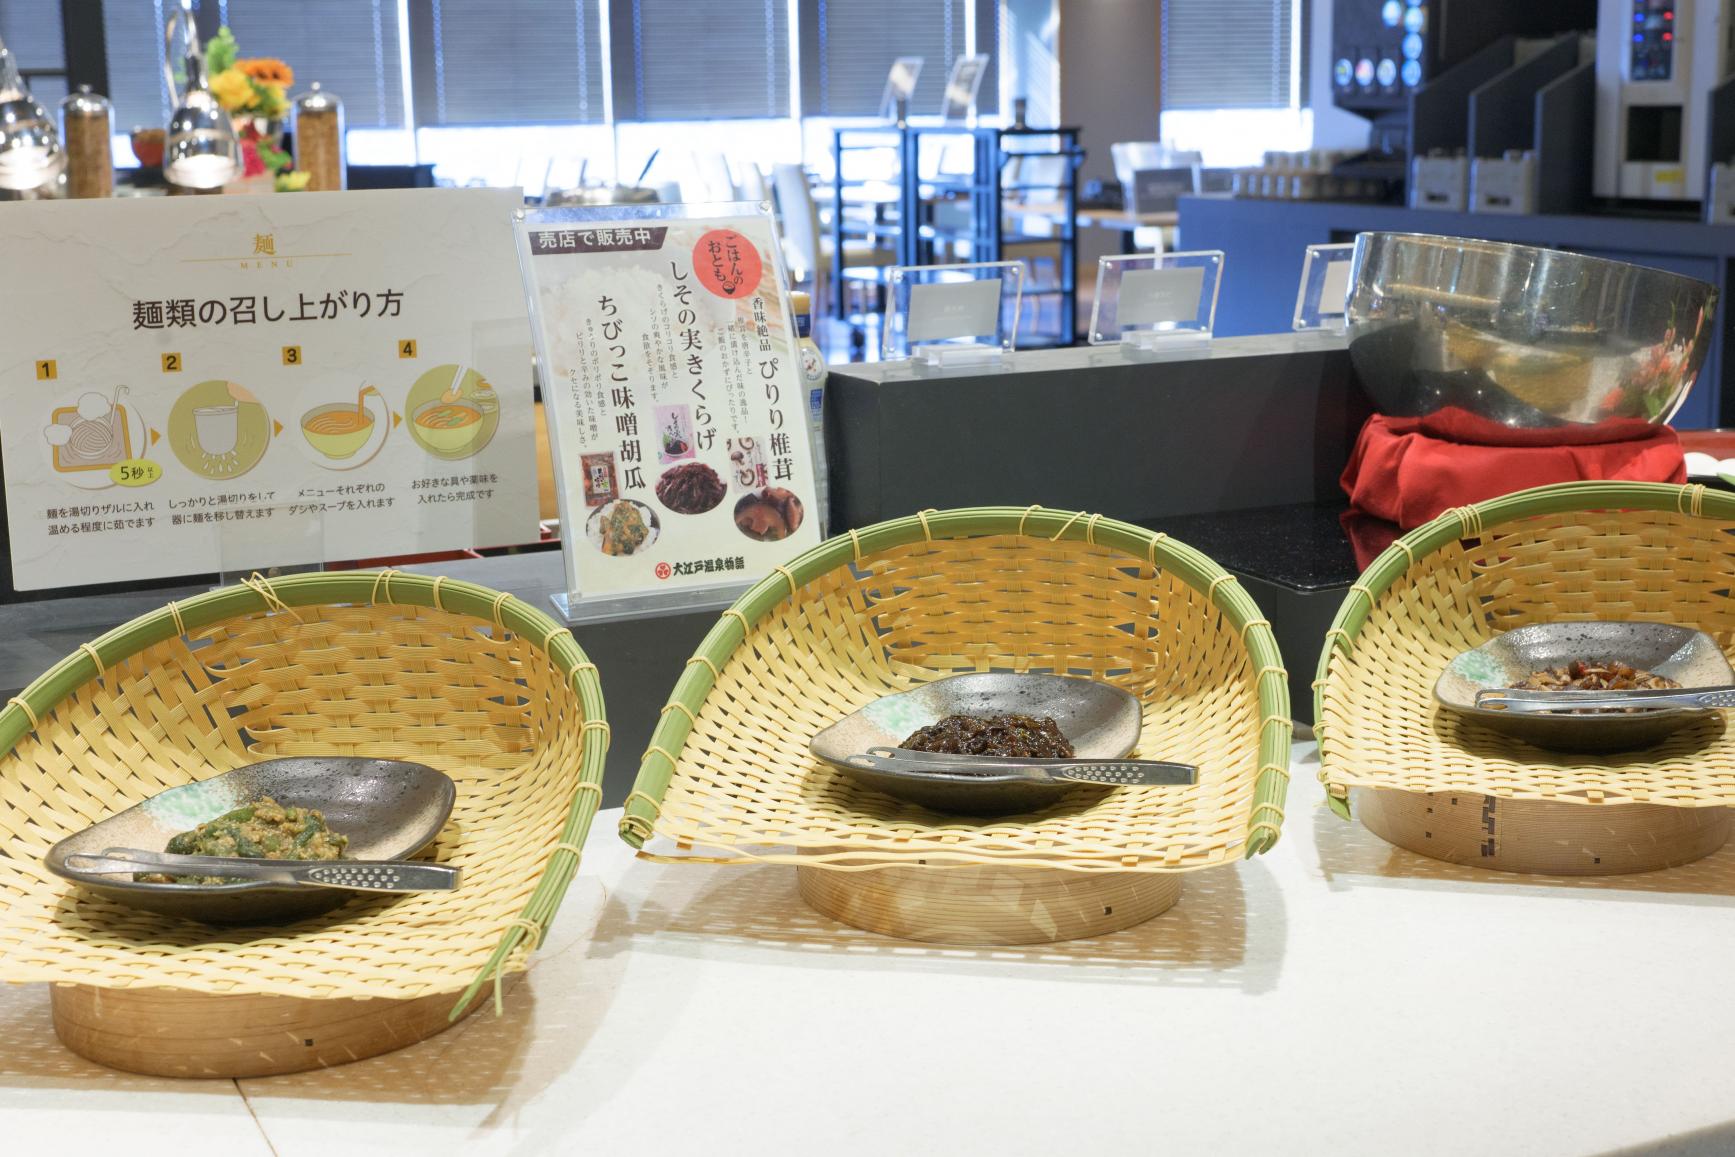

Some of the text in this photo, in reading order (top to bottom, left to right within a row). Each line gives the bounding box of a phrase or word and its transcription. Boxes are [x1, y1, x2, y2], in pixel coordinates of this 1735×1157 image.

[253, 233, 276, 256] 麺
[538, 228, 651, 249] 売店で販売中
[240, 259, 294, 270] MENU
[707, 240, 727, 282] おとも
[725, 234, 744, 285] ごはんの
[132, 288, 405, 331] 麺類の召し上がり方
[751, 296, 771, 352] 香味絶品
[287, 348, 297, 363] 3
[402, 341, 413, 356] 4
[670, 261, 717, 451] しその実きくらげ
[41, 362, 51, 378] 1
[165, 355, 178, 370] 2
[597, 295, 647, 490] ちびっこ味噌胡瓜
[758, 357, 794, 481] ぴりり椎茸
[297, 482, 386, 498] メニューそれぞれの
[411, 473, 499, 490] お好きな具や薬味を
[168, 491, 276, 509] しっかりと湯切りをして
[416, 488, 495, 505] 入れたら完成です
[46, 500, 155, 520] 麺を湯切りザルに入れ
[171, 507, 276, 526] 器に麺を移し替えます
[288, 498, 396, 516] ダシやスープを入れます
[47, 517, 156, 536] 温める程度に茹でます
[672, 556, 745, 577] 大江戸温泉物語
